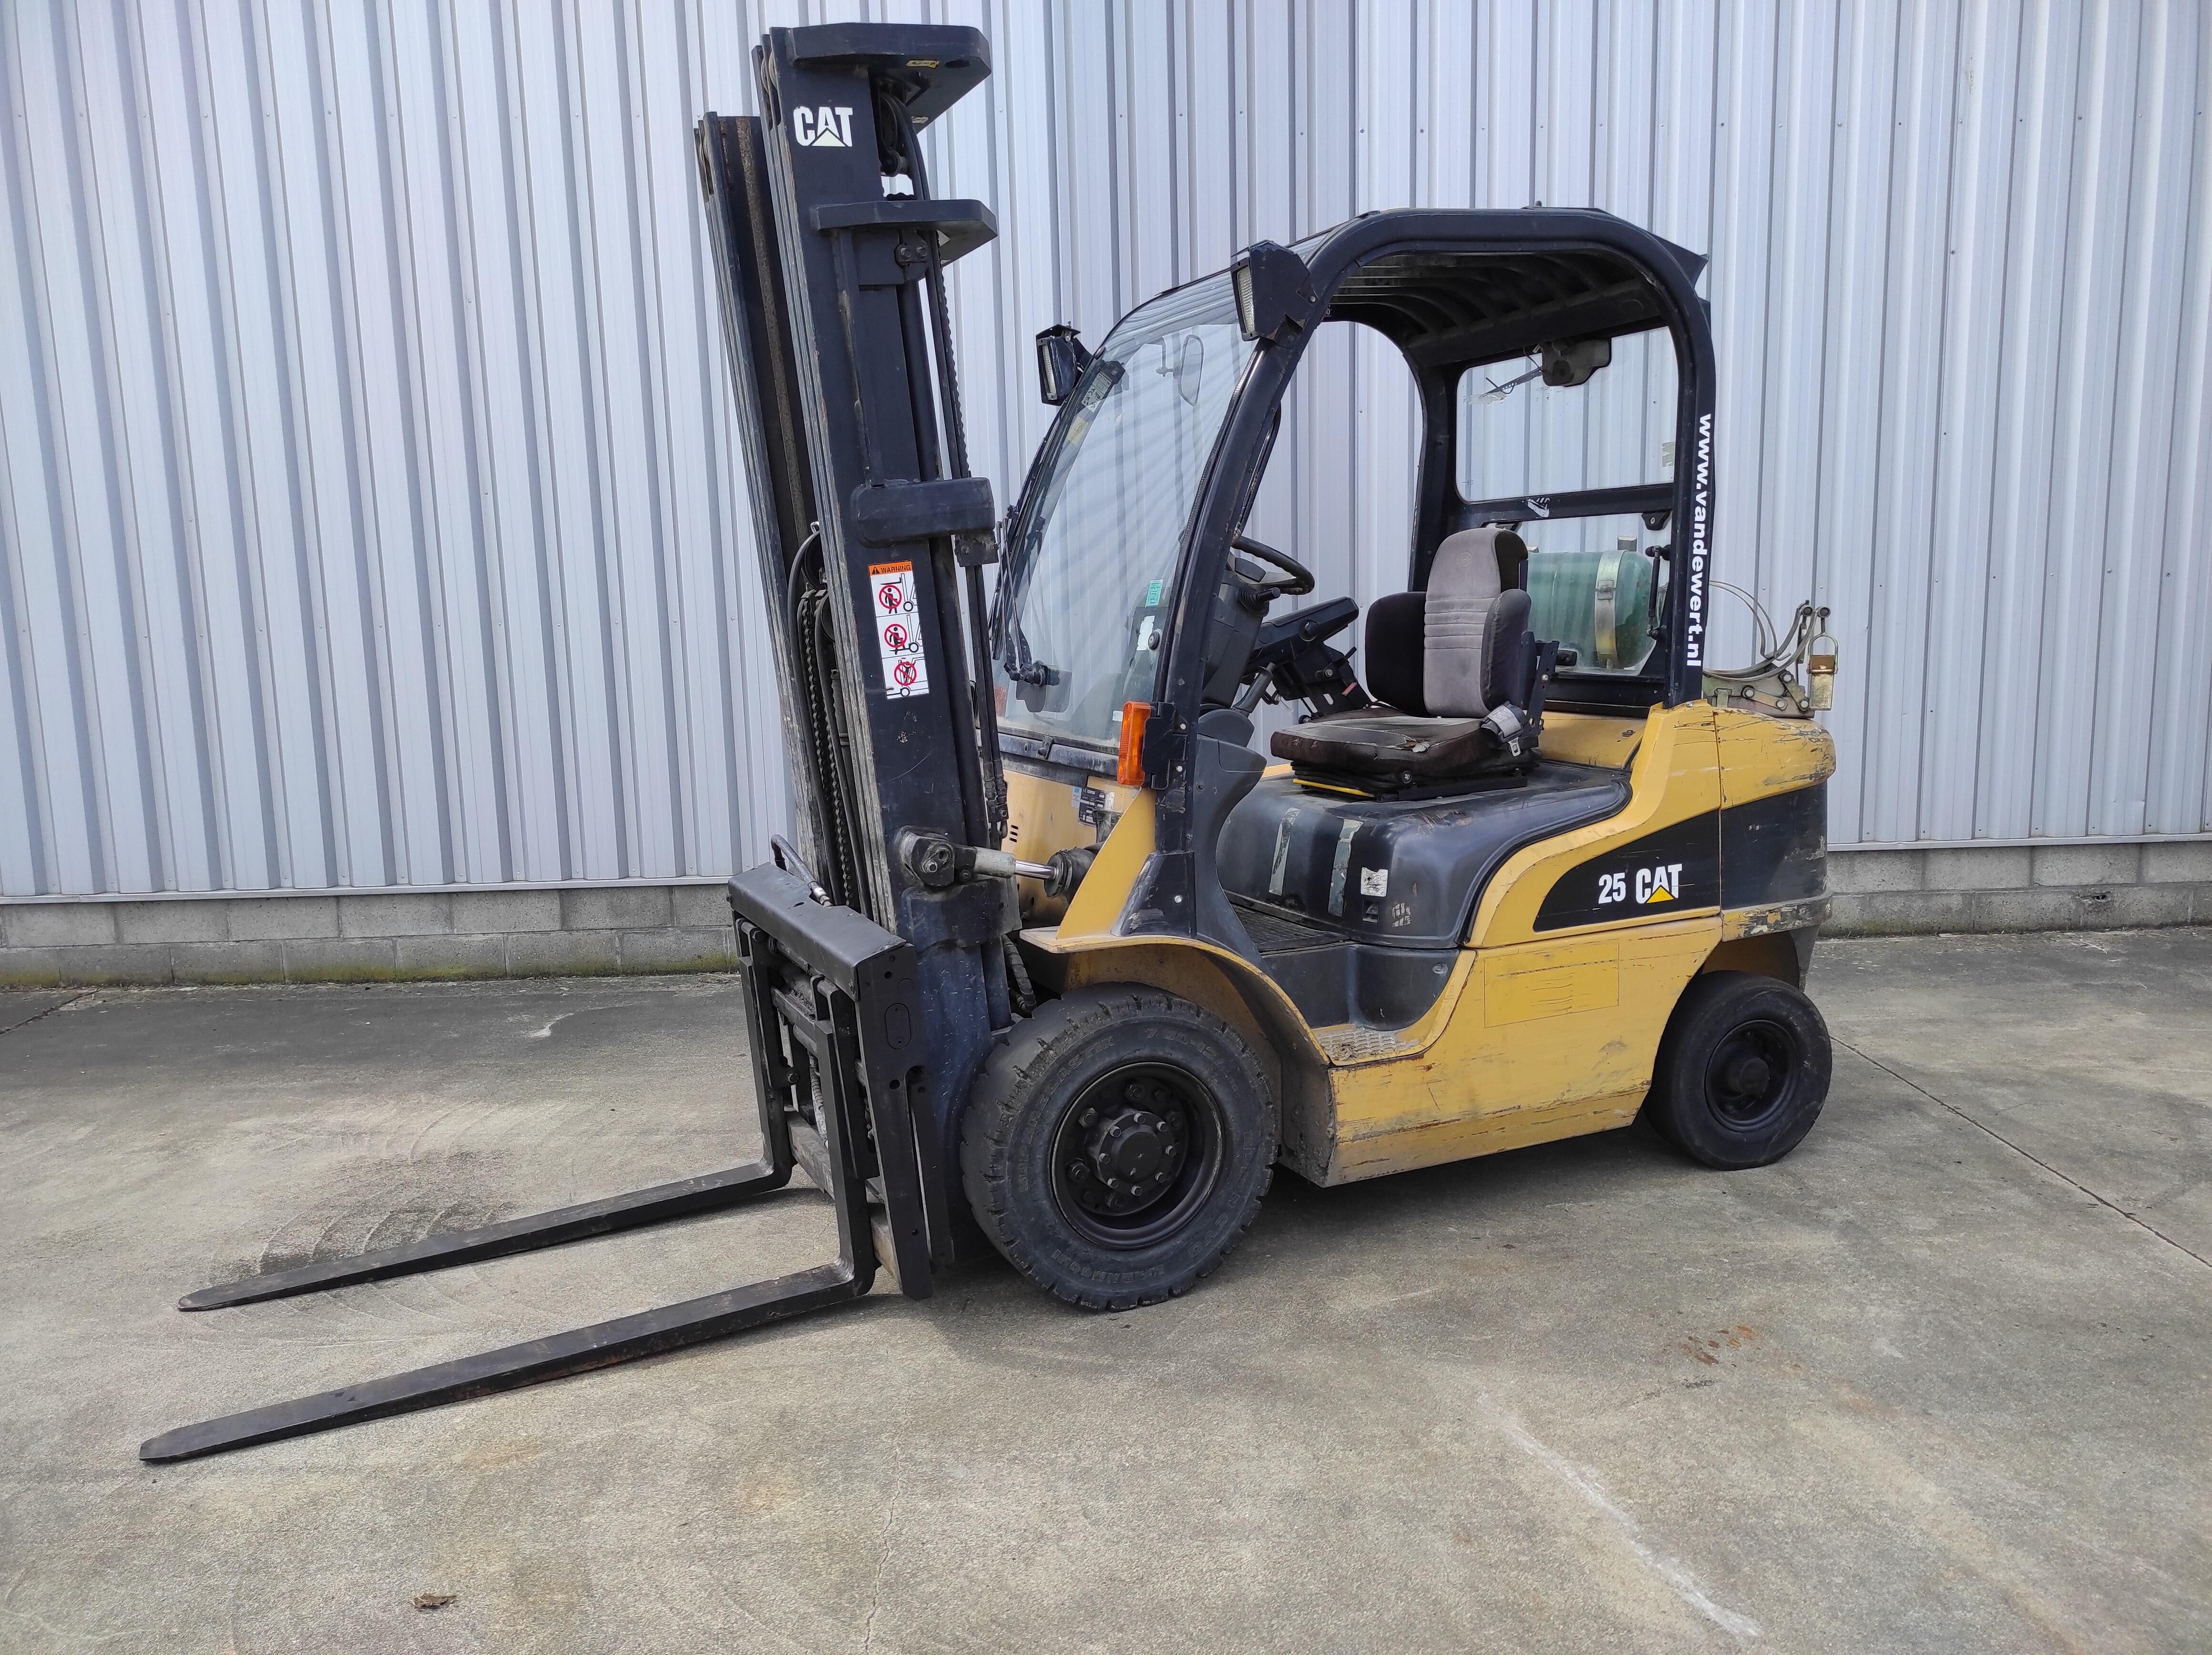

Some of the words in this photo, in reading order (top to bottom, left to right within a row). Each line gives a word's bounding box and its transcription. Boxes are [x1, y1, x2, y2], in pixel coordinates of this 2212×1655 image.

[793, 106, 853, 147] CAT
[1686, 413, 1711, 666] www.vandewert.nl
[880, 564, 911, 574] WARNING
[1598, 872, 1626, 904] 25
[1636, 863, 1682, 904] CAT
